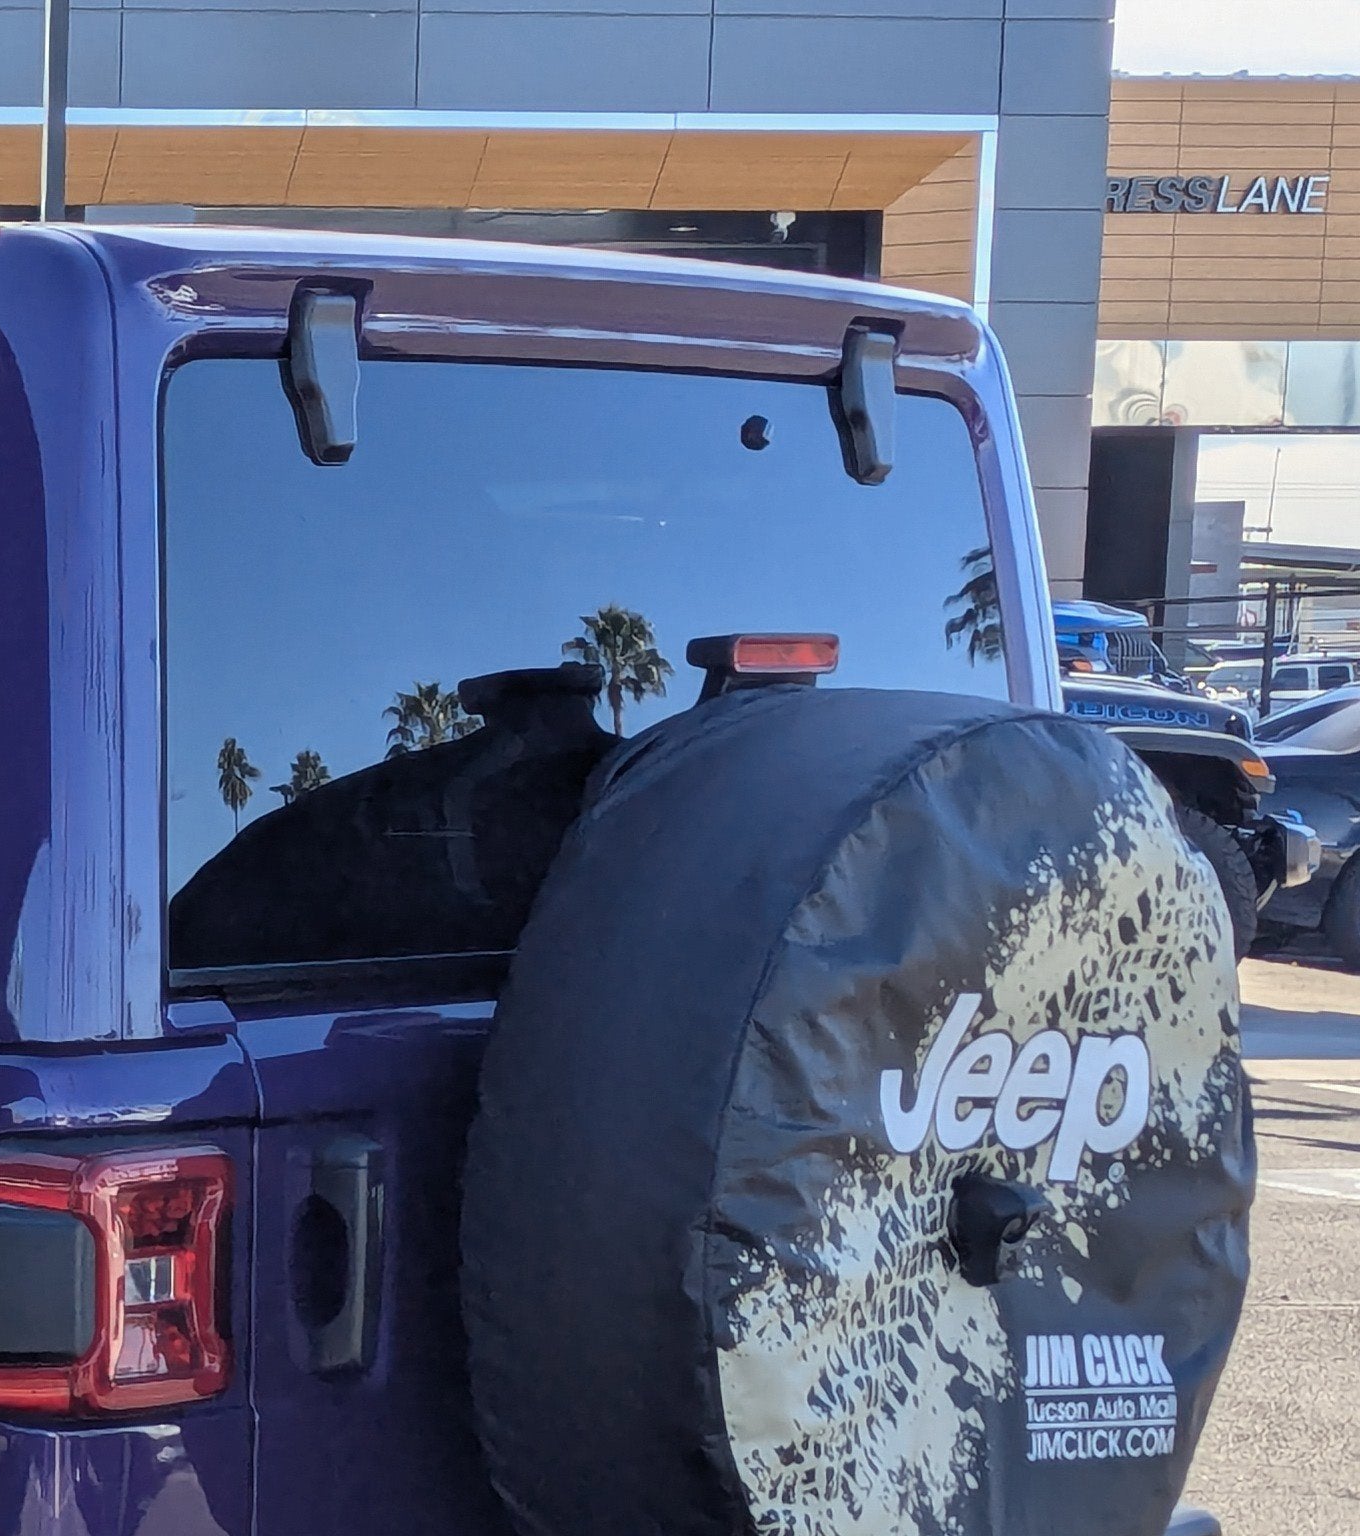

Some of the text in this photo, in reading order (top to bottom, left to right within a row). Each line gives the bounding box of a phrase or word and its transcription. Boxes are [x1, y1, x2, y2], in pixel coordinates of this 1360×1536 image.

[881, 994, 1149, 1181] Jeep
[1025, 1334, 1173, 1386] JIM CLICK
[1026, 1398, 1089, 1422] Tucson
[1093, 1396, 1136, 1419] Auto
[1027, 1427, 1175, 1462] JIMCLICK.COM
